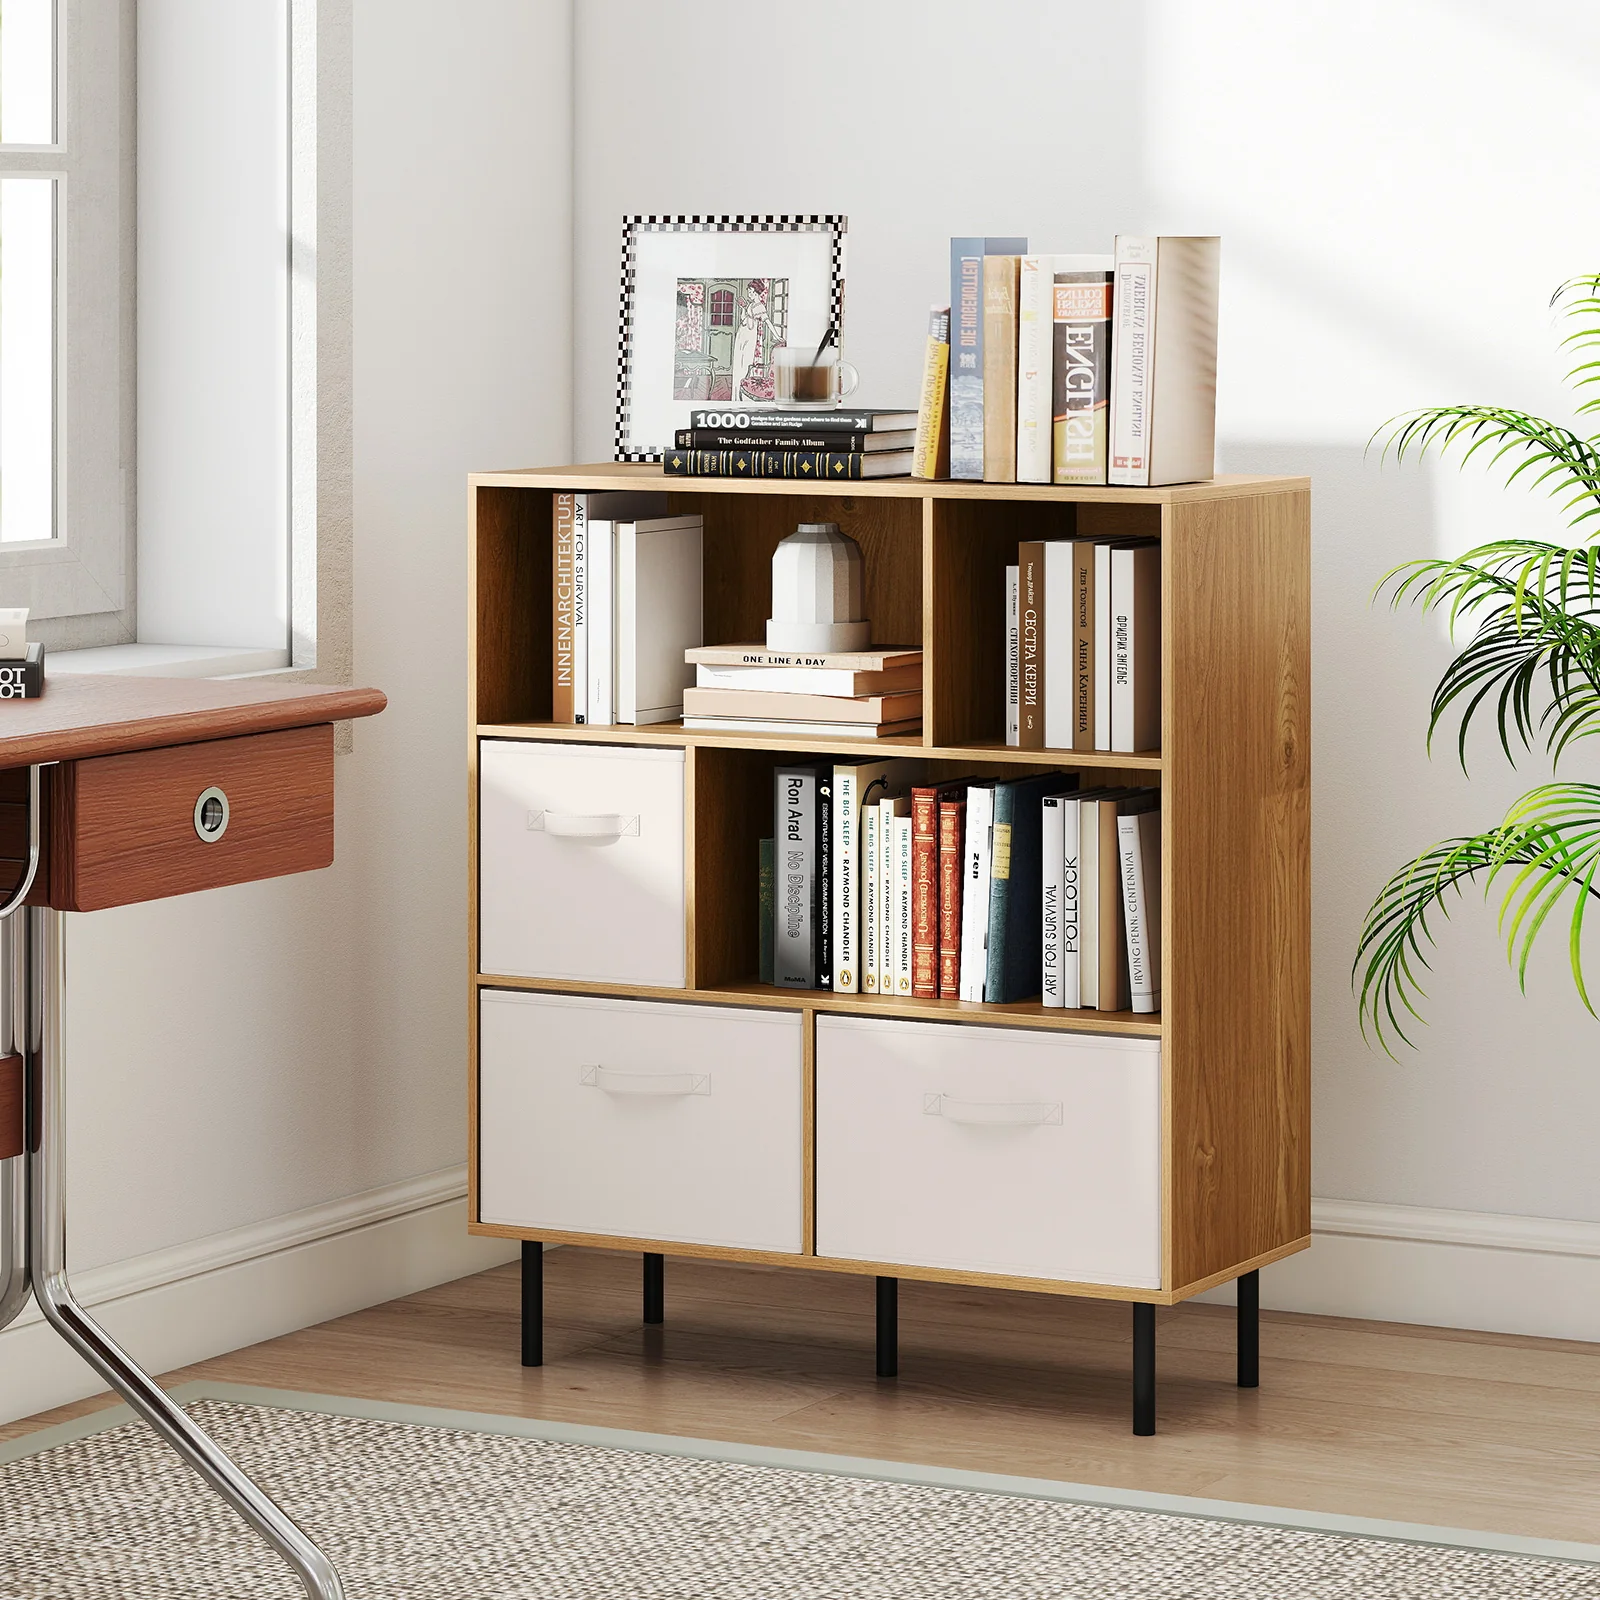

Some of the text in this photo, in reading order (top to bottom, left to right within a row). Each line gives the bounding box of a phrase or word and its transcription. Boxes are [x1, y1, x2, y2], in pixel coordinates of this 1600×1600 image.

[696, 413, 750, 429] 1000
[733, 437, 773, 445] Godfather
[774, 438, 800, 446] Family
[801, 438, 825, 446] Album
[575, 502, 584, 627] ART FOR SURVIVAL
[557, 494, 571, 687] INNENARCHITEKTUR
[1024, 609, 1037, 660] СЕСТРА
[1116, 615, 1128, 685] ФРИДРИХ ЭНГЕЛЬС
[743, 655, 764, 663] ONE
[768, 656, 791, 665] LINE
[805, 658, 826, 666] DAY
[1010, 627, 1018, 704] СТИХОТВОРЕНИЯ
[1024, 664, 1037, 706] КЕРРИ
[821, 803, 829, 843] ESSENTIALS
[821, 843, 829, 853] OF
[784, 778, 804, 938] Ron Arad No Discipline
[821, 853, 829, 877] VISUAL
[842, 779, 850, 962] THE BIG SLEEP RAYMOND CHANDLER
[972, 852, 980, 879] zen
[1124, 850, 1138, 913] CENTENNIAL
[821, 877, 829, 935] COMMUNICATION
[1065, 856, 1078, 953] POLLOCK
[1129, 915, 1142, 944] PENN:
[1045, 884, 1057, 996] ART FOR SURVIVAL
[1131, 947, 1144, 985] IRVING
